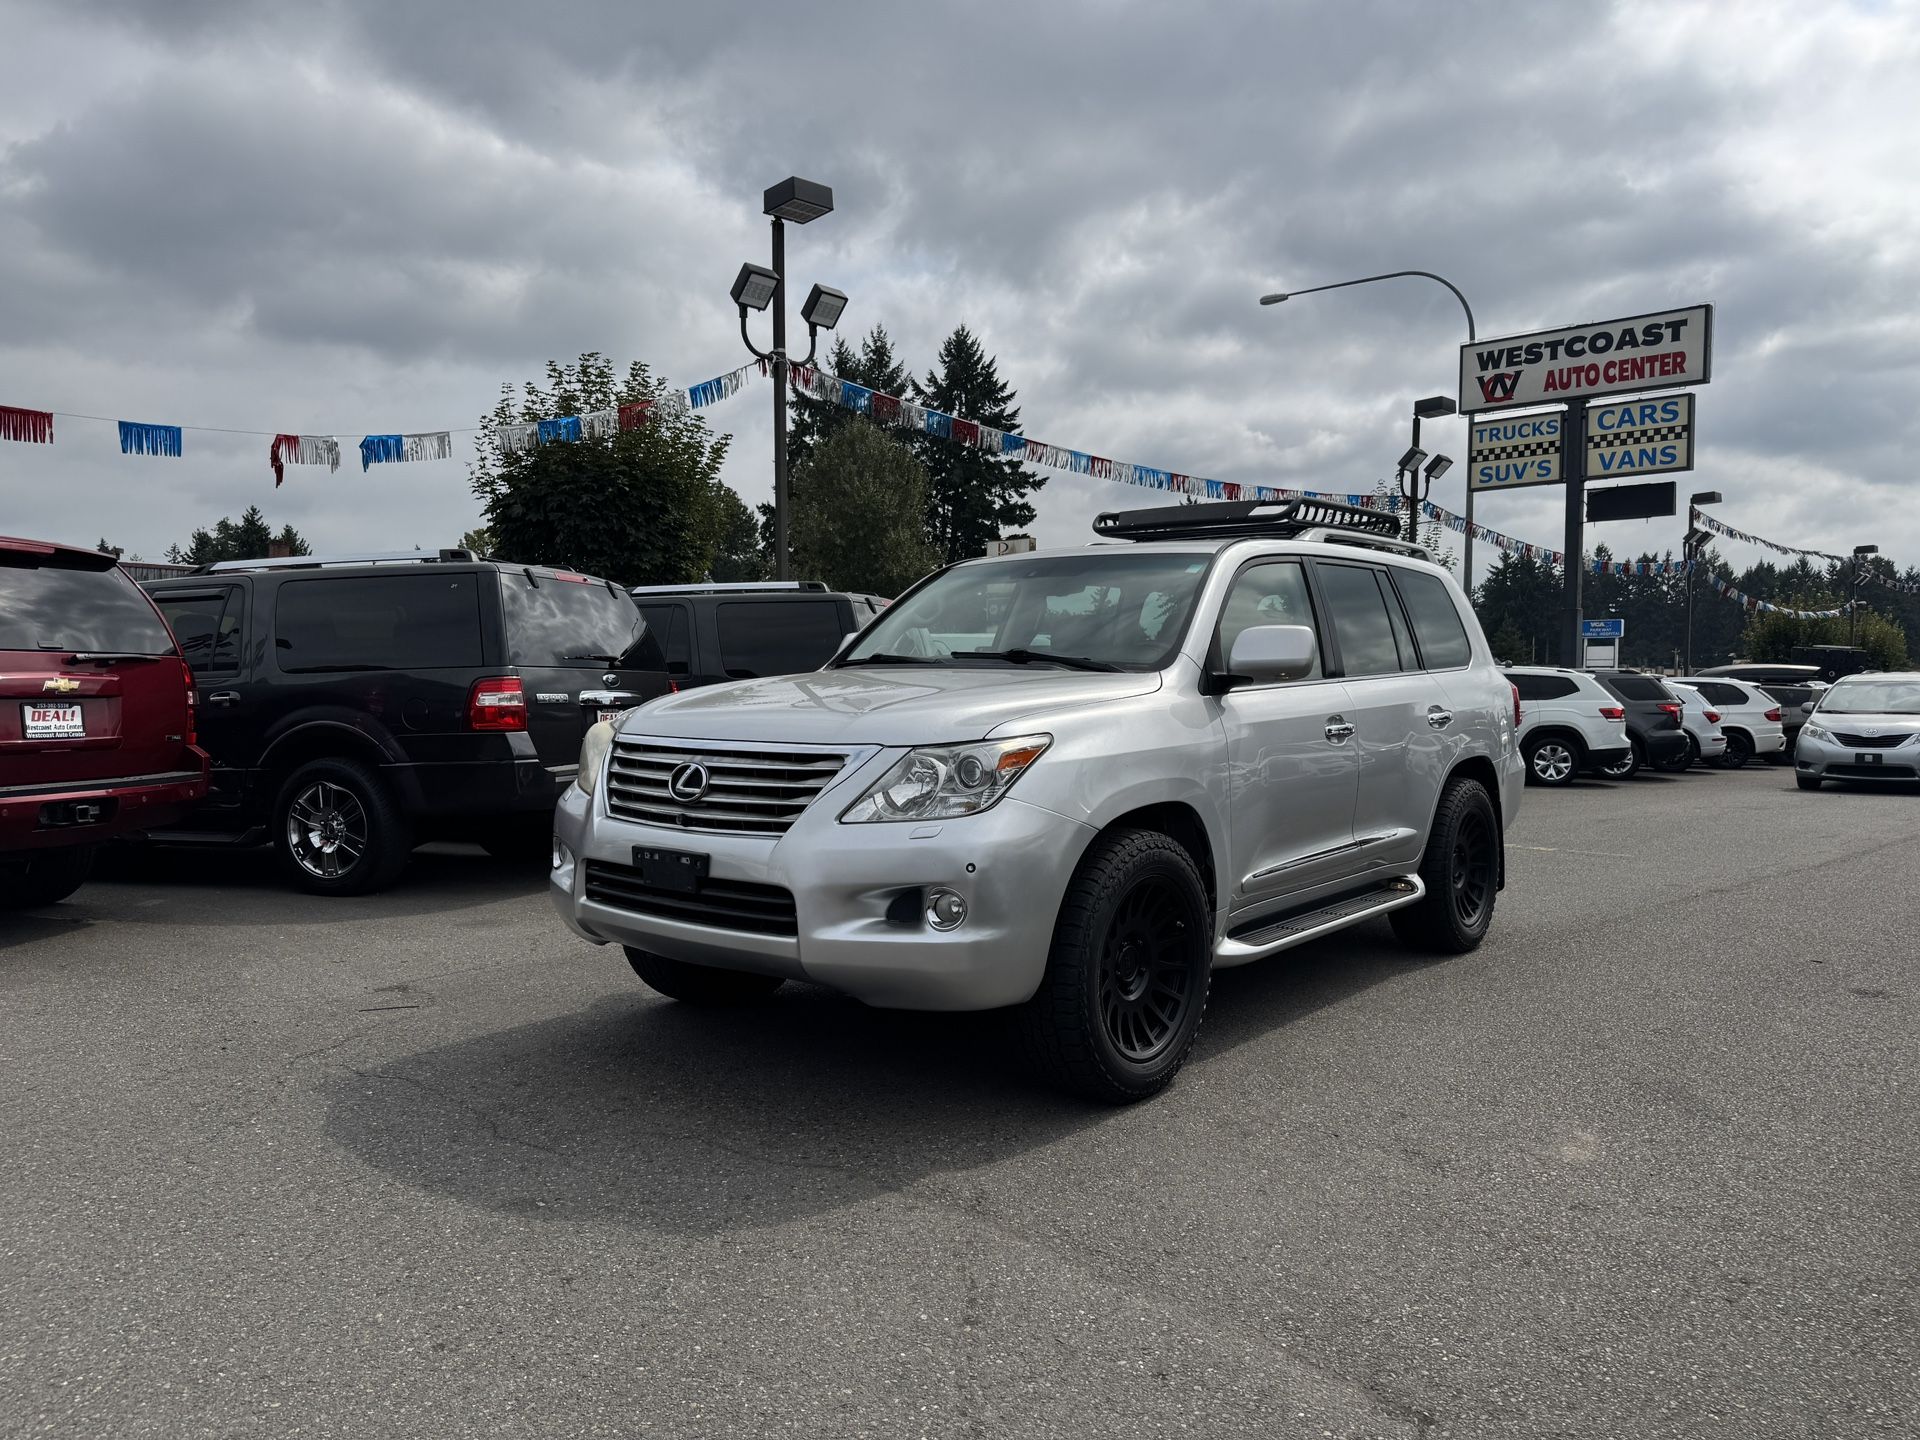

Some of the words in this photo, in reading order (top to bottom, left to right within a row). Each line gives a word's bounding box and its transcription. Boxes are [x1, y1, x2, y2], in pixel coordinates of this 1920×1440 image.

[1476, 318, 1689, 371] WESTCOAST
[1543, 363, 1600, 392] AUTO
[1603, 351, 1686, 384] CENTER
[1597, 401, 1680, 431] CARS
[1475, 419, 1559, 444] TRUCKS
[1598, 445, 1678, 471] VANS
[1479, 459, 1552, 484] SUV'S
[31, 710, 75, 722] DEAL!
